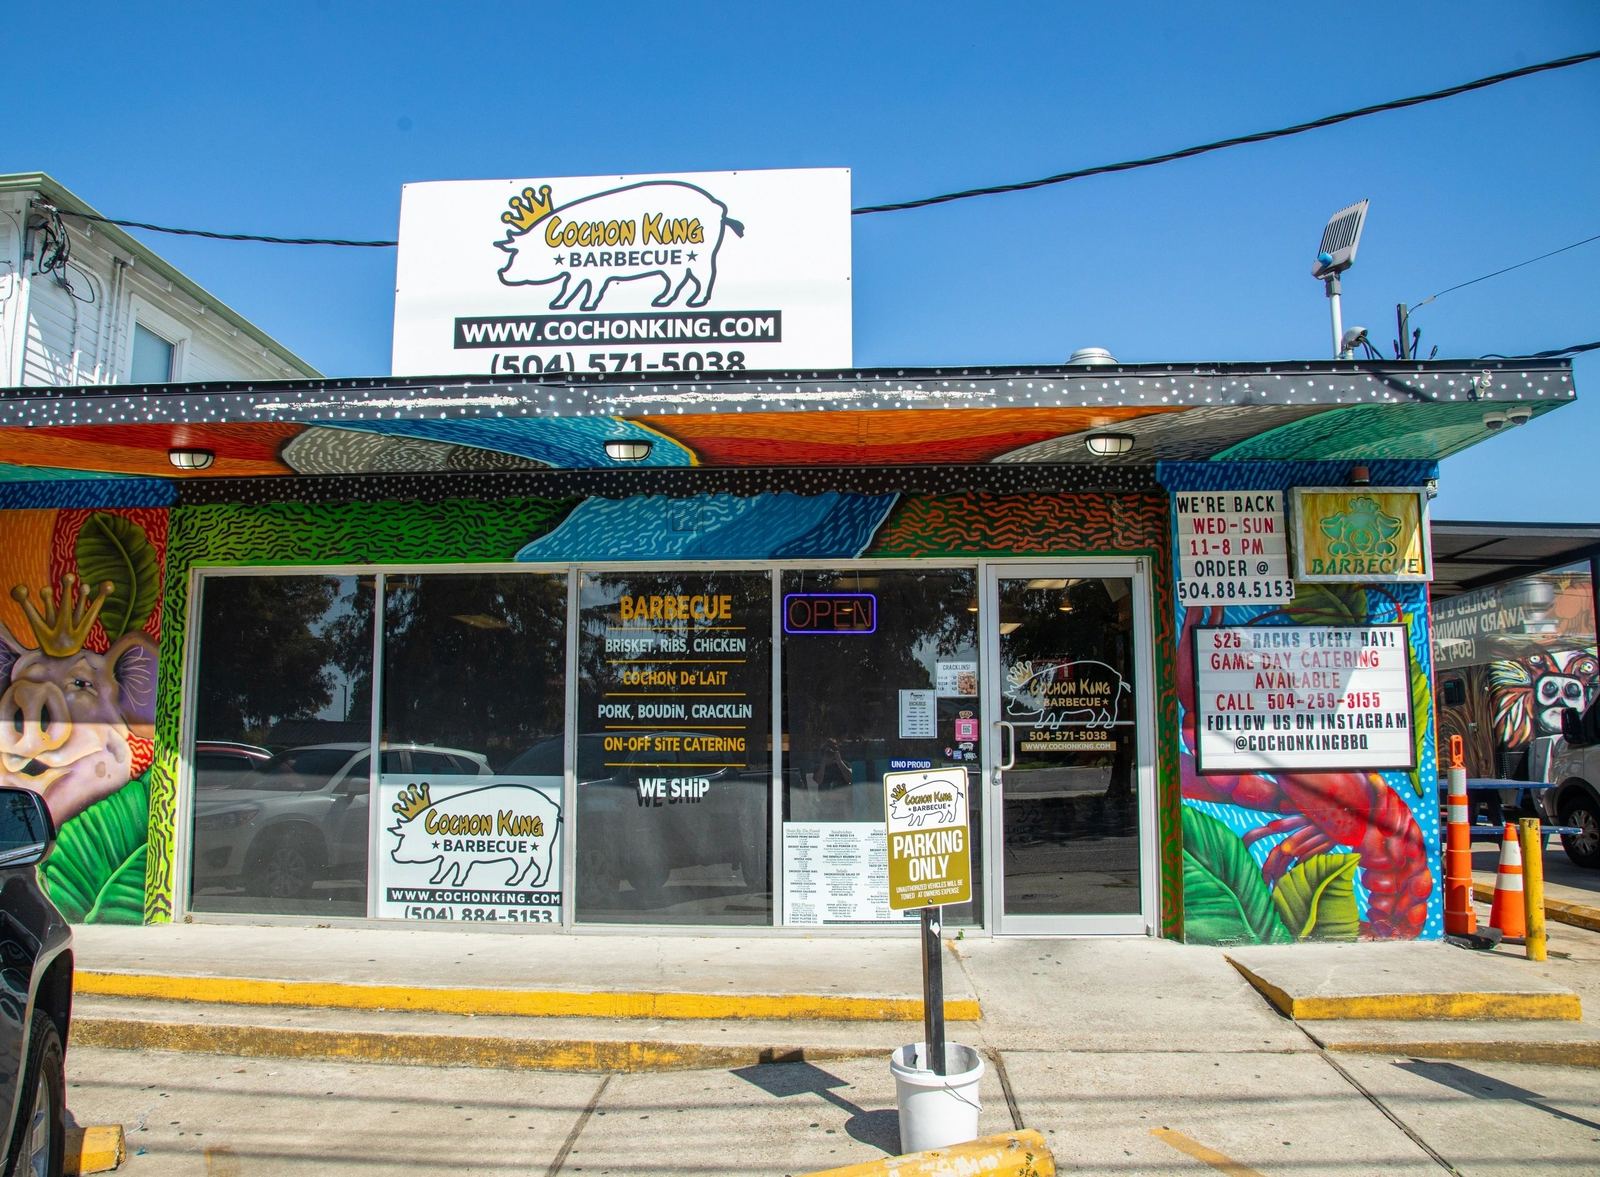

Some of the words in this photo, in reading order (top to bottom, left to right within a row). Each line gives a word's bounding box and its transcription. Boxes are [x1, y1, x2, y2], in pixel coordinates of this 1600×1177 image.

[569, 249, 682, 268] BARBECUE
[462, 317, 775, 342] WWW.COCHONKING.COM
[490, 352, 575, 374] (504)
[588, 350, 747, 372] 571-5038
[1234, 495, 1275, 512] BACK
[1193, 517, 1274, 534] WED-SUN
[1191, 539, 1231, 556] 11-8
[1242, 538, 1264, 555] PM
[1194, 560, 1248, 577] ORDER
[1256, 560, 1269, 576] @
[1311, 558, 1420, 574] BARBECUE
[1178, 580, 1294, 600] 504.884.5153
[620, 595, 732, 620] BARBECUE
[789, 599, 872, 628] OPEN
[1213, 633, 1241, 650] $25
[1253, 631, 1300, 649] RACKS
[1309, 631, 1352, 648] EVERY
[1361, 631, 1395, 648] DAY!
[1210, 652, 1254, 671] GAME
[1260, 651, 1292, 669] DAY
[1300, 650, 1380, 669] CATERING
[623, 671, 677, 686] COCHON
[1255, 672, 1340, 690] AVAILABLE
[1043, 697, 1101, 707] BARBECUE
[1216, 693, 1254, 711] CALL
[1267, 691, 1381, 710] 504-259-3155
[598, 704, 634, 720] PORK,
[1207, 714, 1265, 731] FOLLOW
[1272, 714, 1291, 730] US
[1297, 714, 1314, 730] ON
[1321, 712, 1407, 730] INSTAGRAM
[604, 737, 651, 752] ON-OFF
[1029, 731, 1107, 740] 504-571-5038
[1235, 734, 1369, 751] @COCHONKINGBBQ
[907, 760, 931, 768] PROUD
[638, 778, 667, 797] WE
[912, 803, 947, 812] BARBECUE
[443, 839, 527, 853] BARBECUE
[893, 829, 963, 860] PARKING
[908, 855, 949, 882] ONLY
[404, 905, 454, 920] (504)
[461, 908, 553, 923] 884-5153
